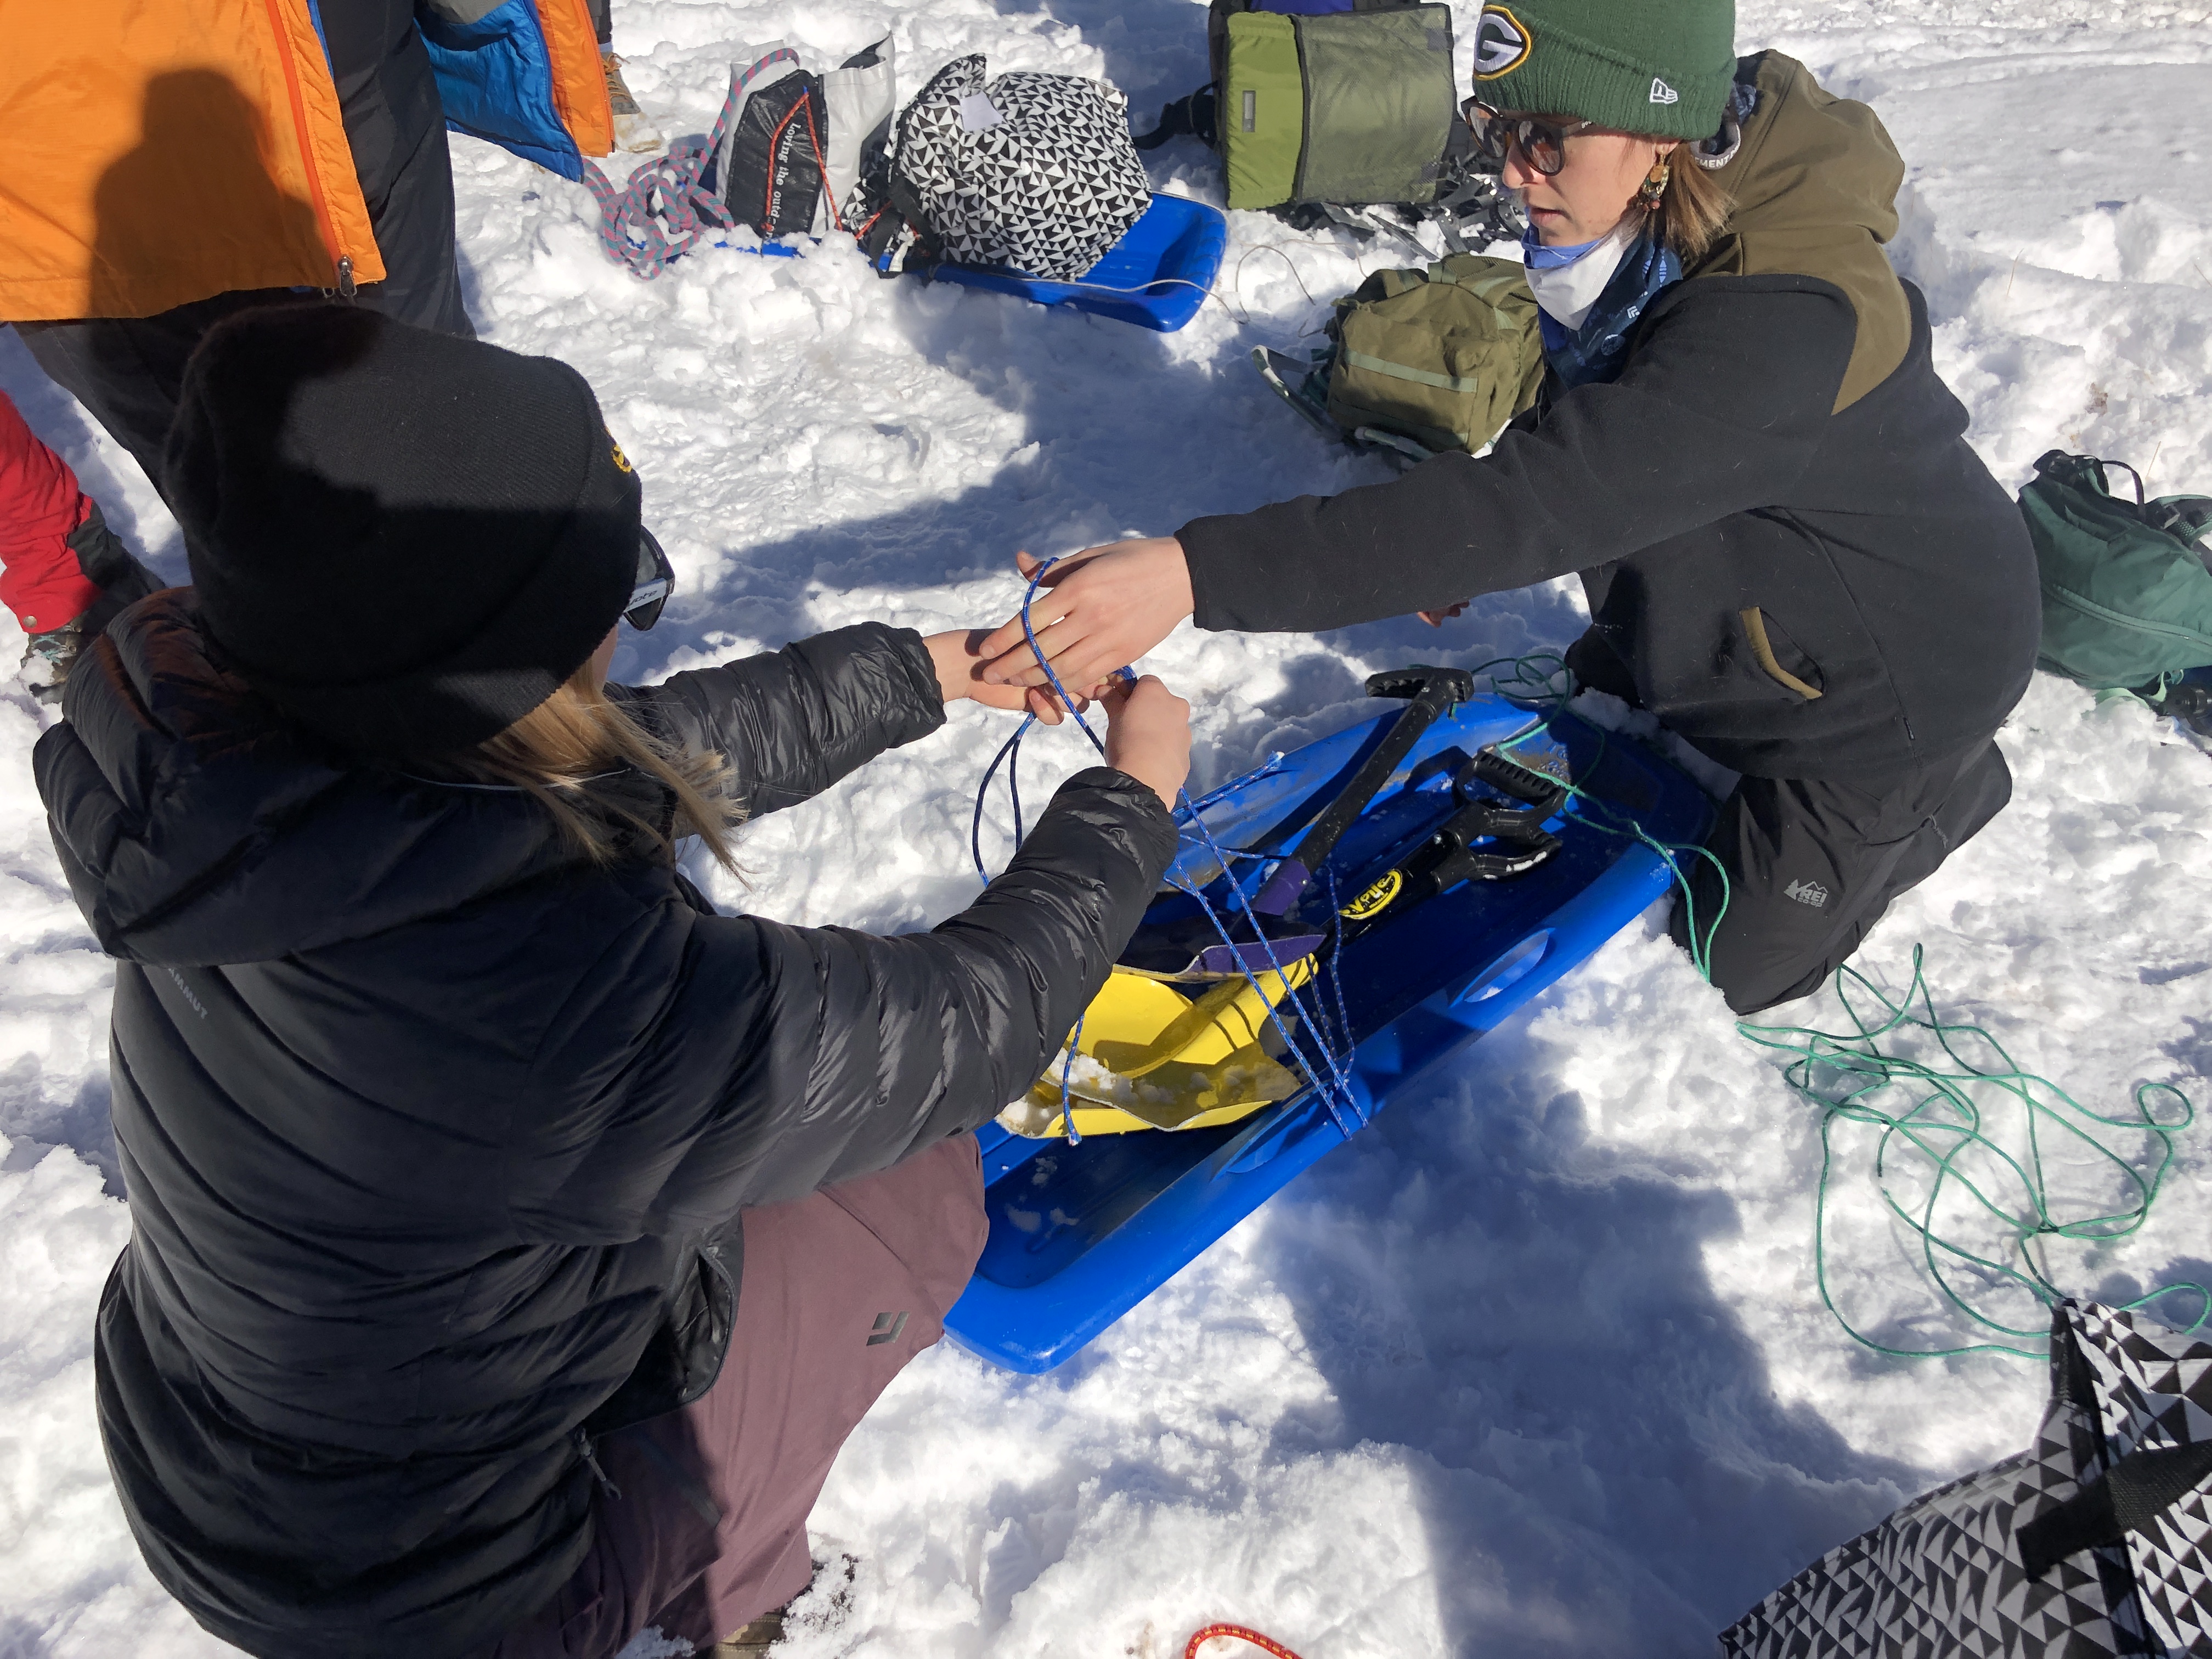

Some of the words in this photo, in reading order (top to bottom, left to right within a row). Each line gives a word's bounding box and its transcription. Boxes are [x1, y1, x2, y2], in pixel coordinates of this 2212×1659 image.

[777, 122, 802, 163] Loving
[775, 166, 790, 187] the
[1799, 888, 1827, 904] REI
